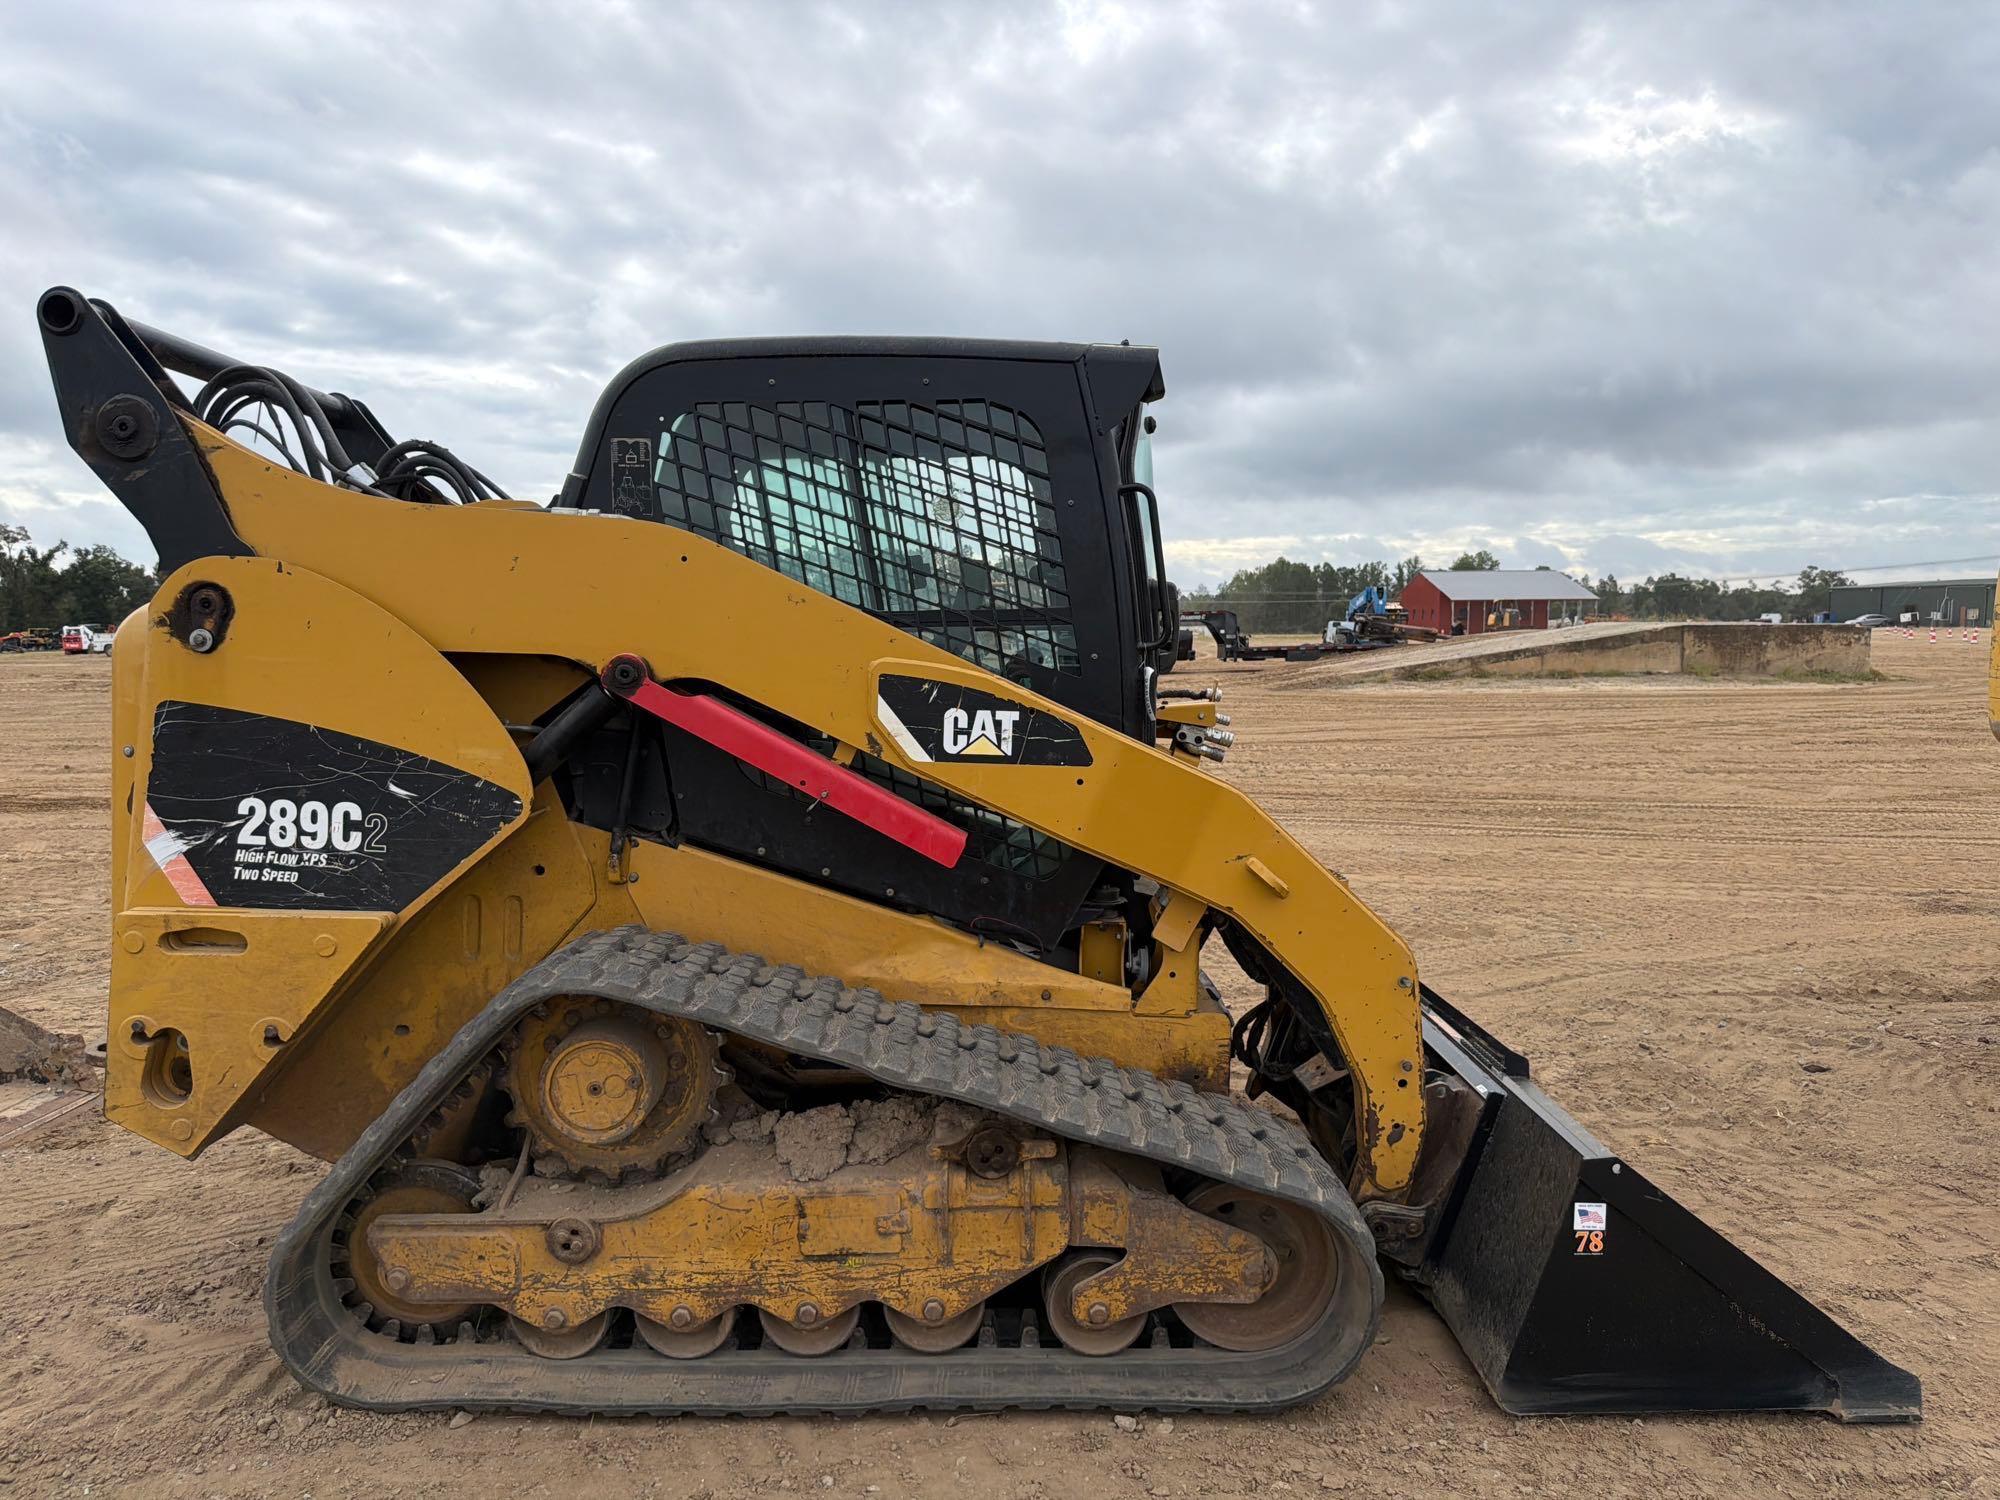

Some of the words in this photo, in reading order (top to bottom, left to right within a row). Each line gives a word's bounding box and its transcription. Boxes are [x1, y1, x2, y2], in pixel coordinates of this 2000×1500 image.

[943, 707, 1020, 756] CAT
[235, 849, 263, 863] HIGH
[266, 851, 299, 865] FLOW
[301, 853, 328, 867] XPS
[233, 866, 259, 881] TWO
[261, 868, 299, 883] SPEED
[1575, 1231, 1604, 1253] 78
